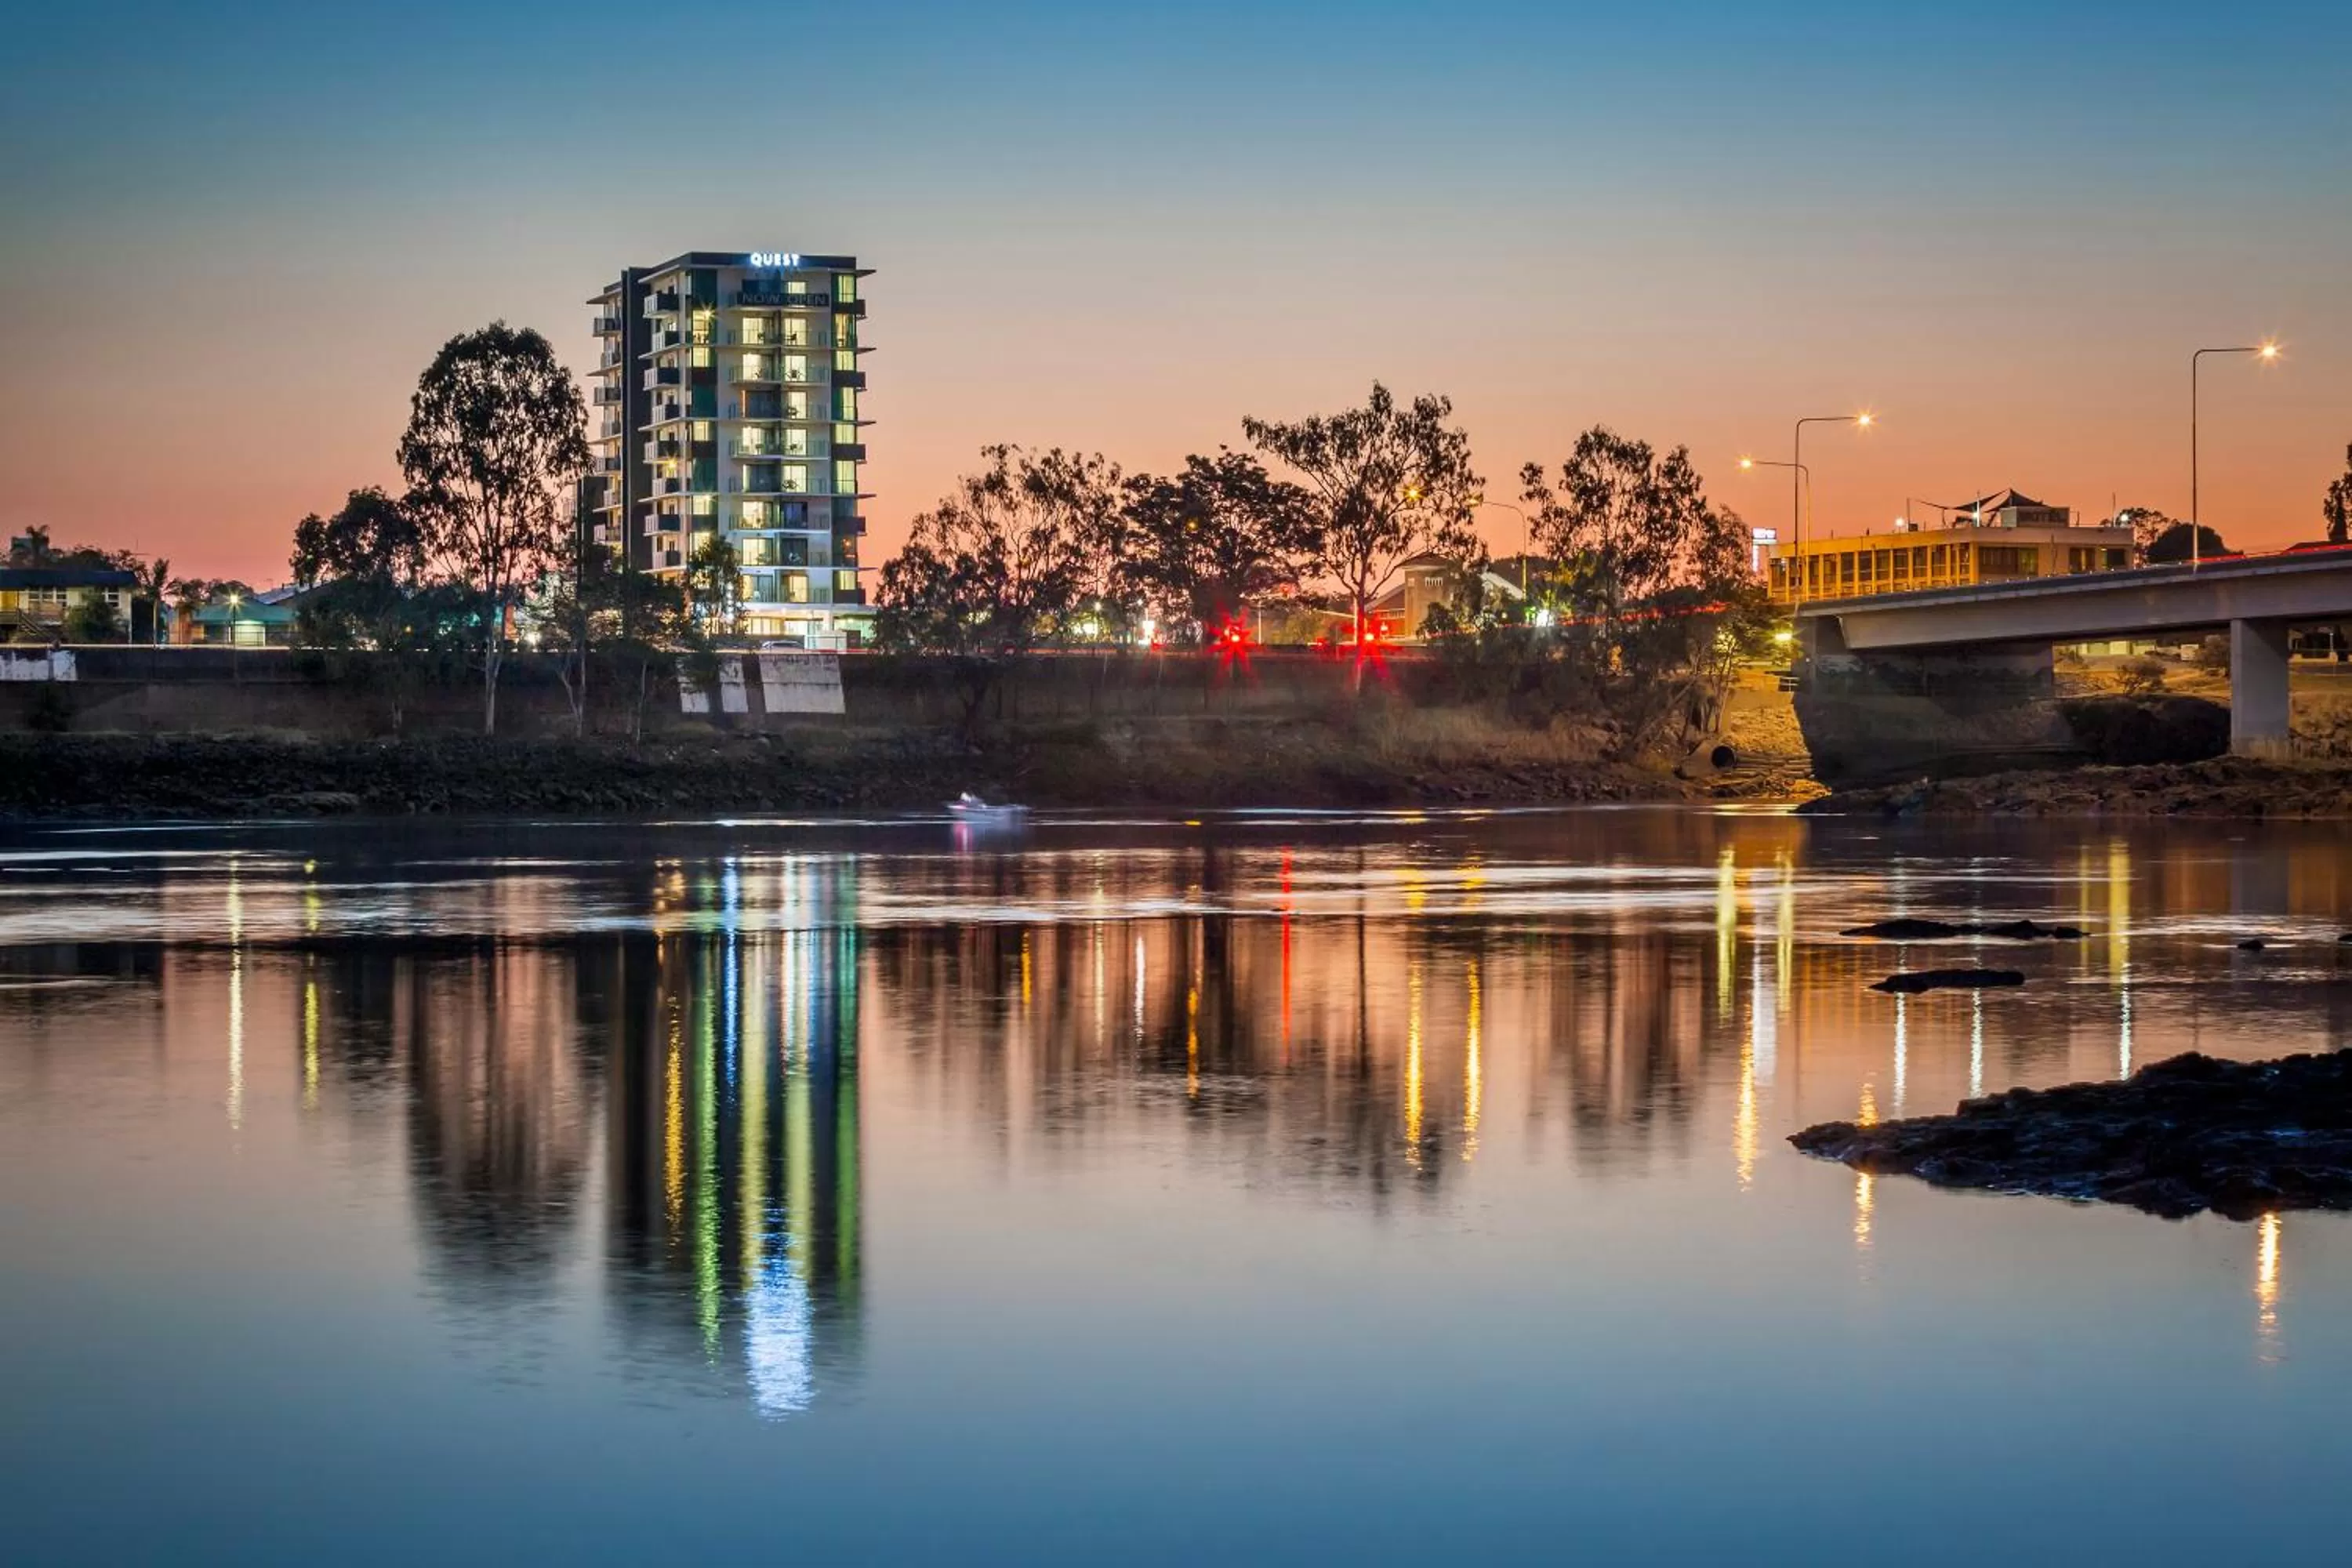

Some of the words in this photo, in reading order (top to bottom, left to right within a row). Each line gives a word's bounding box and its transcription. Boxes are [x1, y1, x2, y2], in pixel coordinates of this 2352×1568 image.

[750, 252, 799, 267] QUEST
[742, 293, 779, 303] NOW
[786, 294, 826, 304] OPEN
